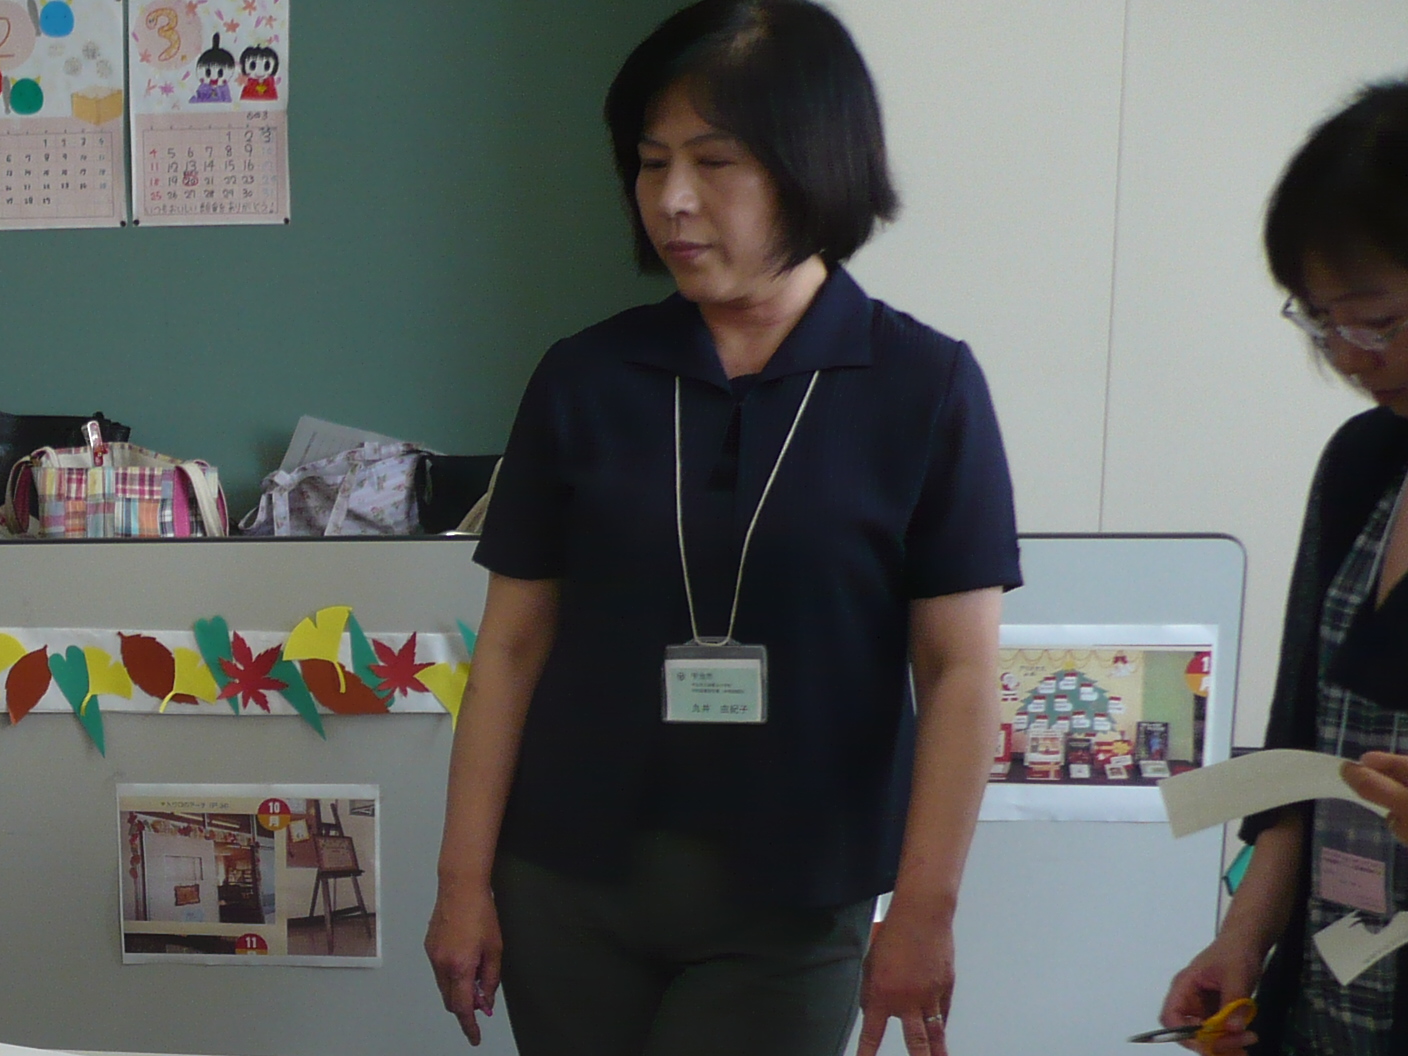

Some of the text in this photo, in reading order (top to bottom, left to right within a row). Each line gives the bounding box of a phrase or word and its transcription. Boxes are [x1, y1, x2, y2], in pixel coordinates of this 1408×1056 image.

[145, 7, 181, 62] 3
[167, 147, 176, 158] 5
[187, 147, 194, 158] 6
[205, 146, 213, 158] 7
[225, 145, 232, 157] 8
[244, 144, 253, 157] 9
[167, 162, 178, 173] 12
[185, 160, 197, 172] 13
[203, 160, 215, 171] 14
[224, 160, 235, 171] 15
[243, 159, 254, 171] 16
[268, 802, 280, 813] 10
[245, 937, 257, 949] 11
